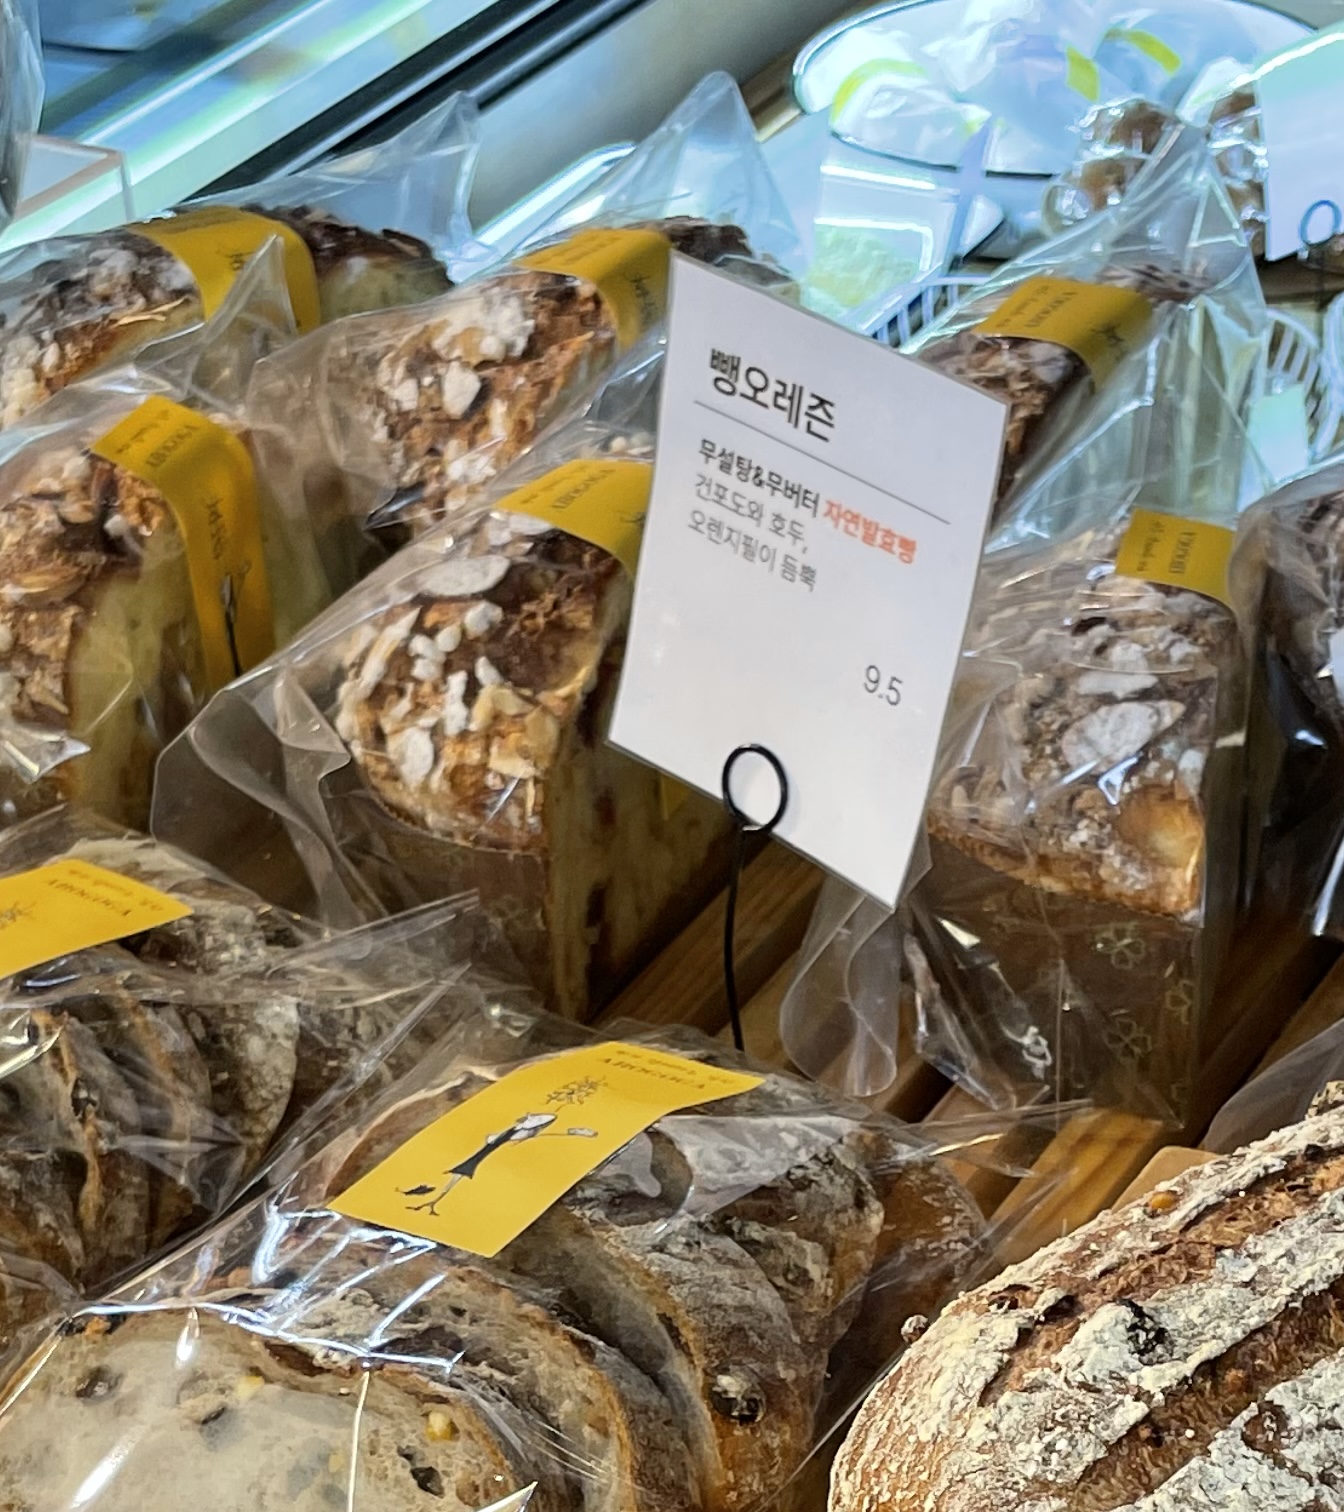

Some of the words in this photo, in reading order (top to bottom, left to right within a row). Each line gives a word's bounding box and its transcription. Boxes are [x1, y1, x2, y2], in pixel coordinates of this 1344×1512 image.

[709, 348, 836, 443] 뺑오레즌
[694, 472, 764, 528] 건포도와
[698, 437, 821, 519] 무설탕&무버터
[862, 664, 905, 707] 9.5
